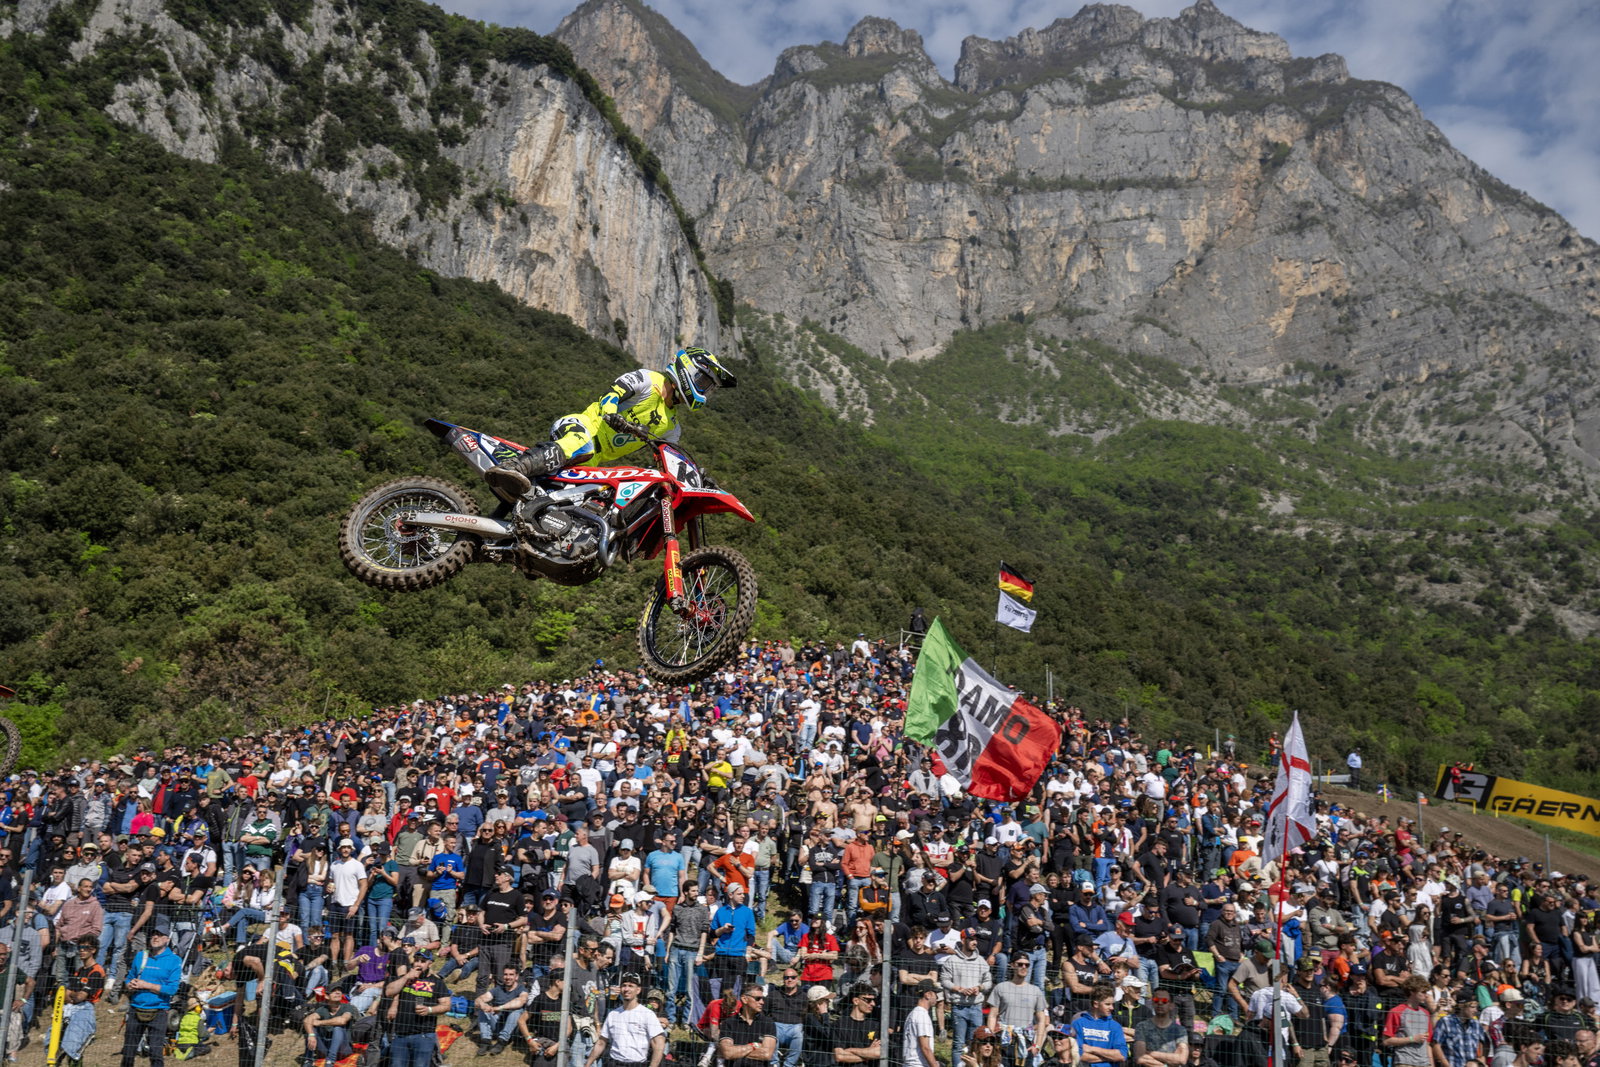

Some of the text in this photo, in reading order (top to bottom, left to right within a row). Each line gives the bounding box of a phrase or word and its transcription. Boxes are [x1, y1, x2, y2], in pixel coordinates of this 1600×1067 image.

[560, 468, 665, 480] ONDA
[444, 515, 478, 525] CHOHO
[662, 508, 672, 533] SHOWA
